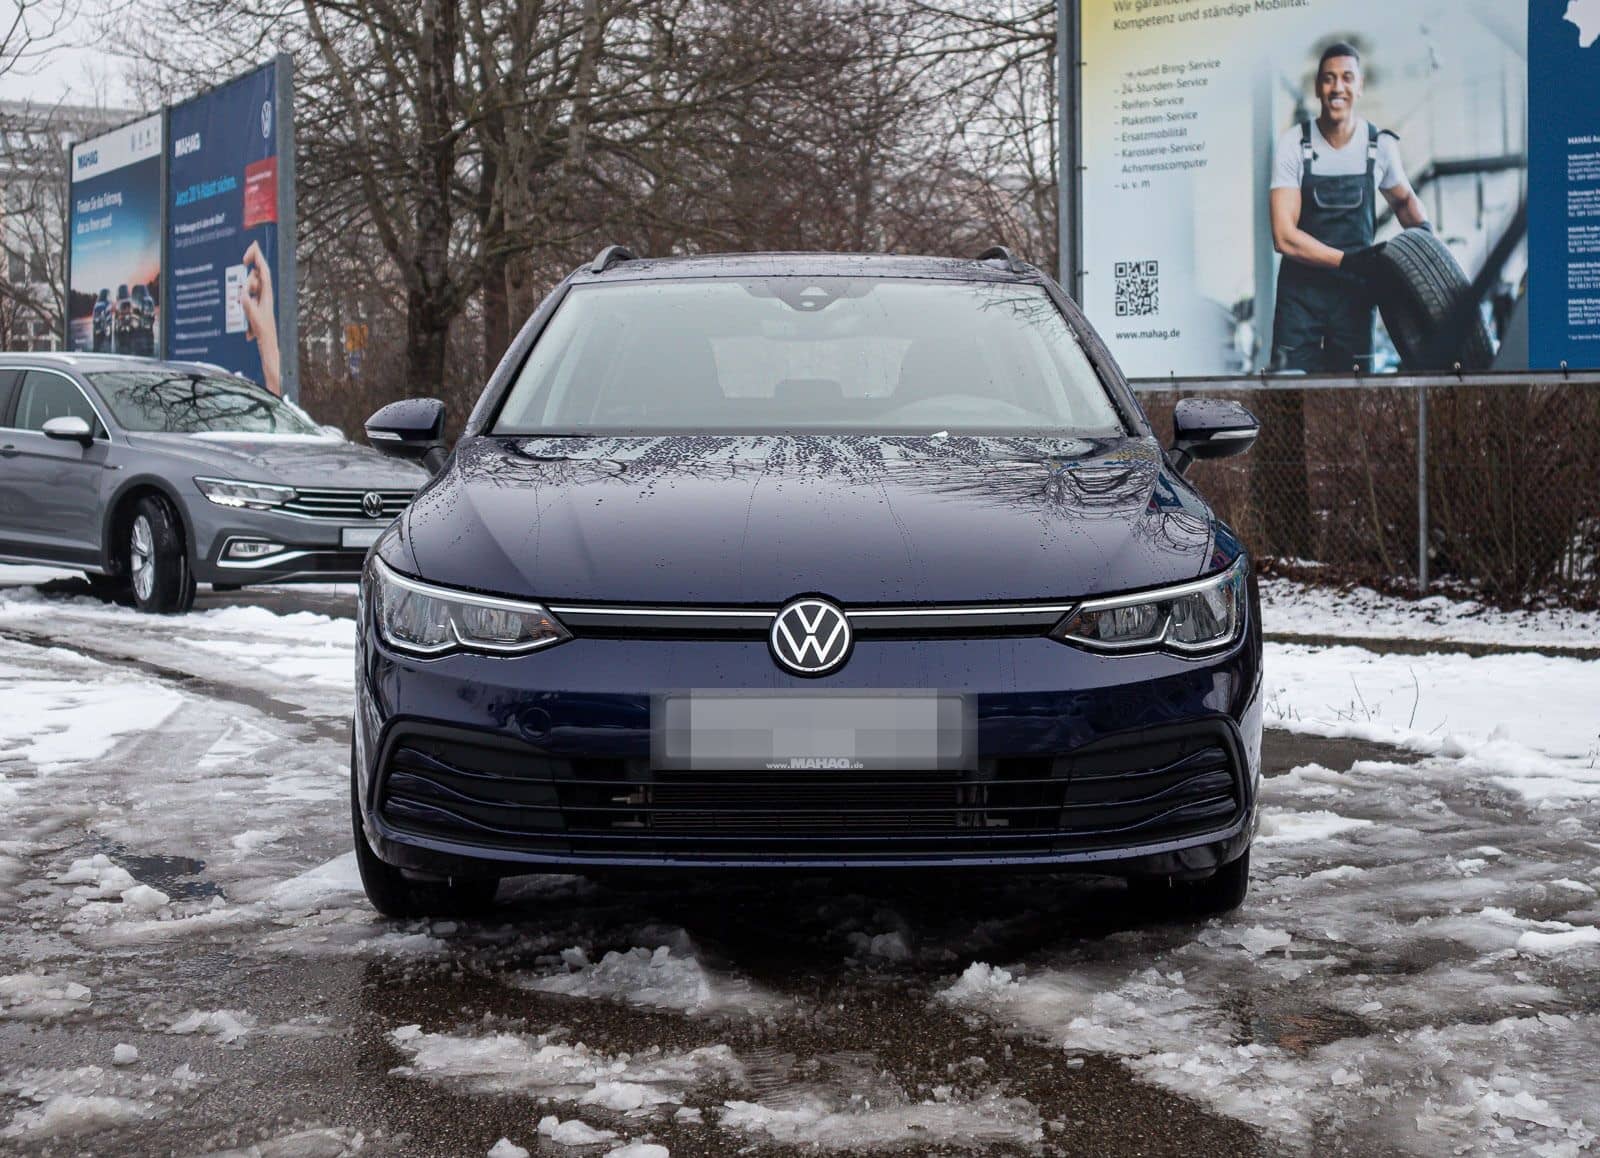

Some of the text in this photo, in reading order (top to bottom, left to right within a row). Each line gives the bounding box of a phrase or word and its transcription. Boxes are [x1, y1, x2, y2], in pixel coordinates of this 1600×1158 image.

[1114, 1, 1132, 12] Wir
[1113, 14, 1175, 31] Kompetenz
[1178, 8, 1200, 22] und
[1202, 3, 1251, 19] ständige
[1121, 97, 1184, 110] Reifen-Service
[1121, 112, 1198, 127] Plaketten-Service
[1121, 128, 1187, 142] Ersatzmobilität
[1121, 160, 1208, 174] Achsmesscomputer
[1115, 328, 1181, 341] www.mahag.de
